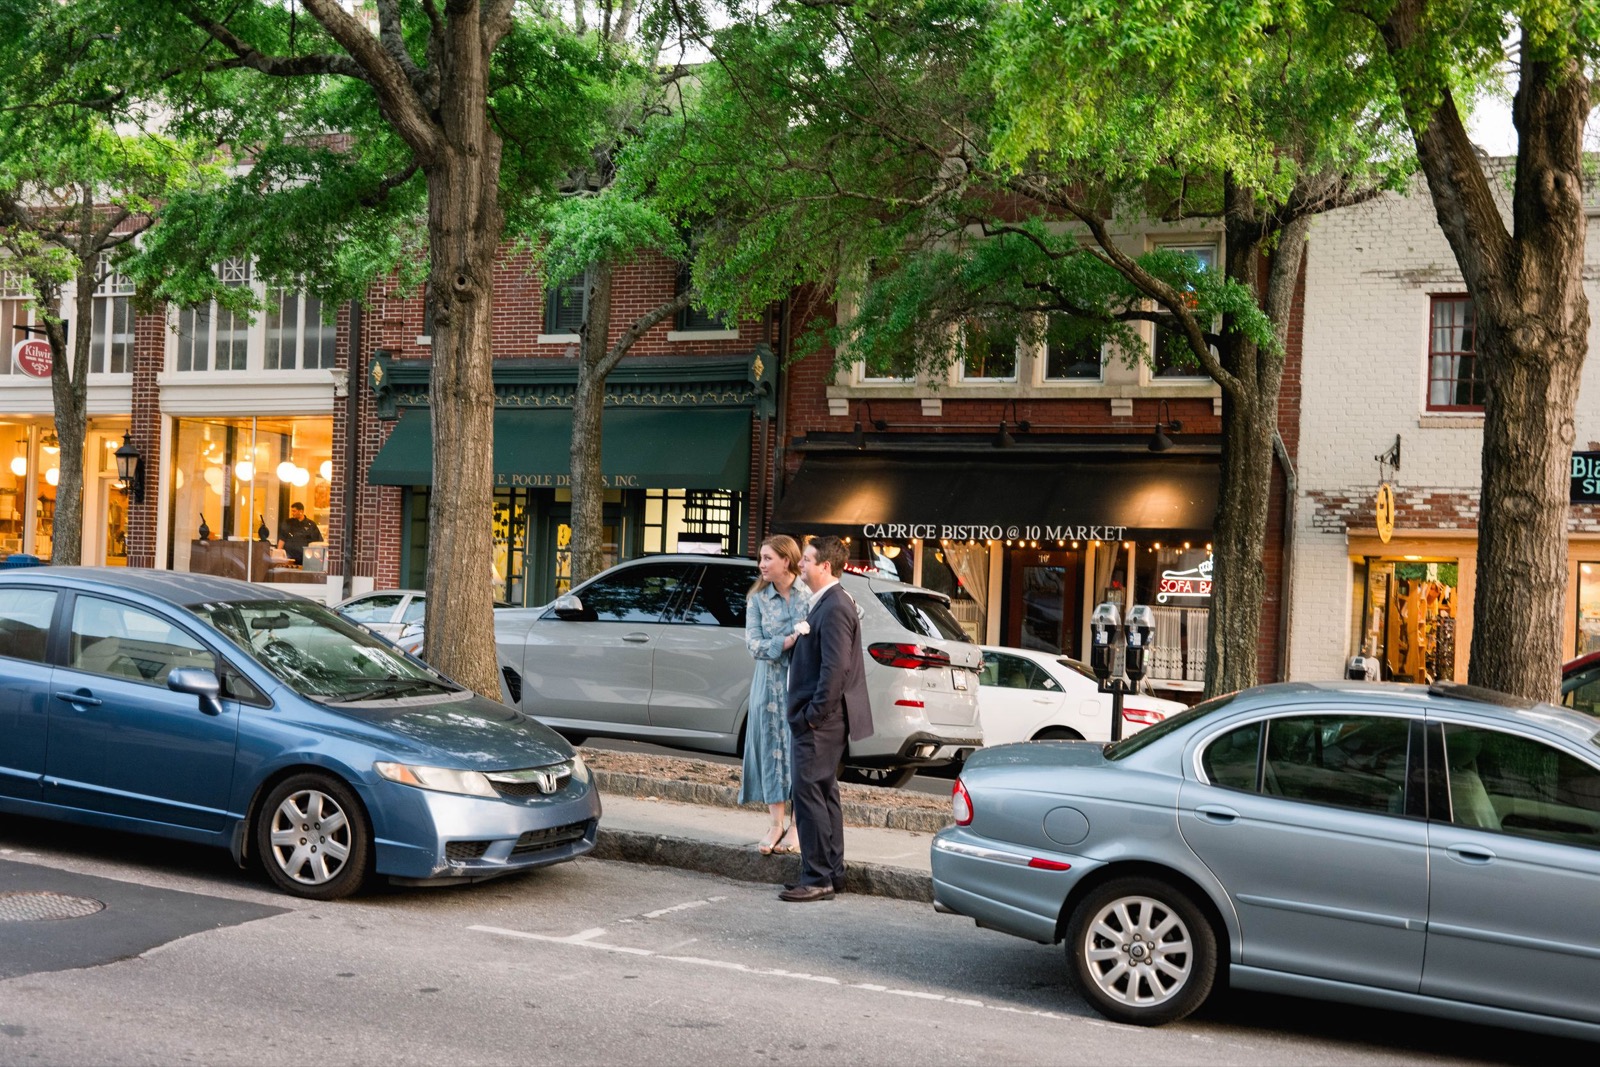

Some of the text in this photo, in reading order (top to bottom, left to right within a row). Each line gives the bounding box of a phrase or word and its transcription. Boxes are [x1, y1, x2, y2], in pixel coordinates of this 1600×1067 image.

[498, 473, 508, 485] E.
[512, 474, 552, 486] POOLE
[615, 475, 640, 486] INC.
[863, 523, 1127, 541] CAPRICE BISTRO @ 10 MARKET
[1160, 579, 1193, 594] SOFA
